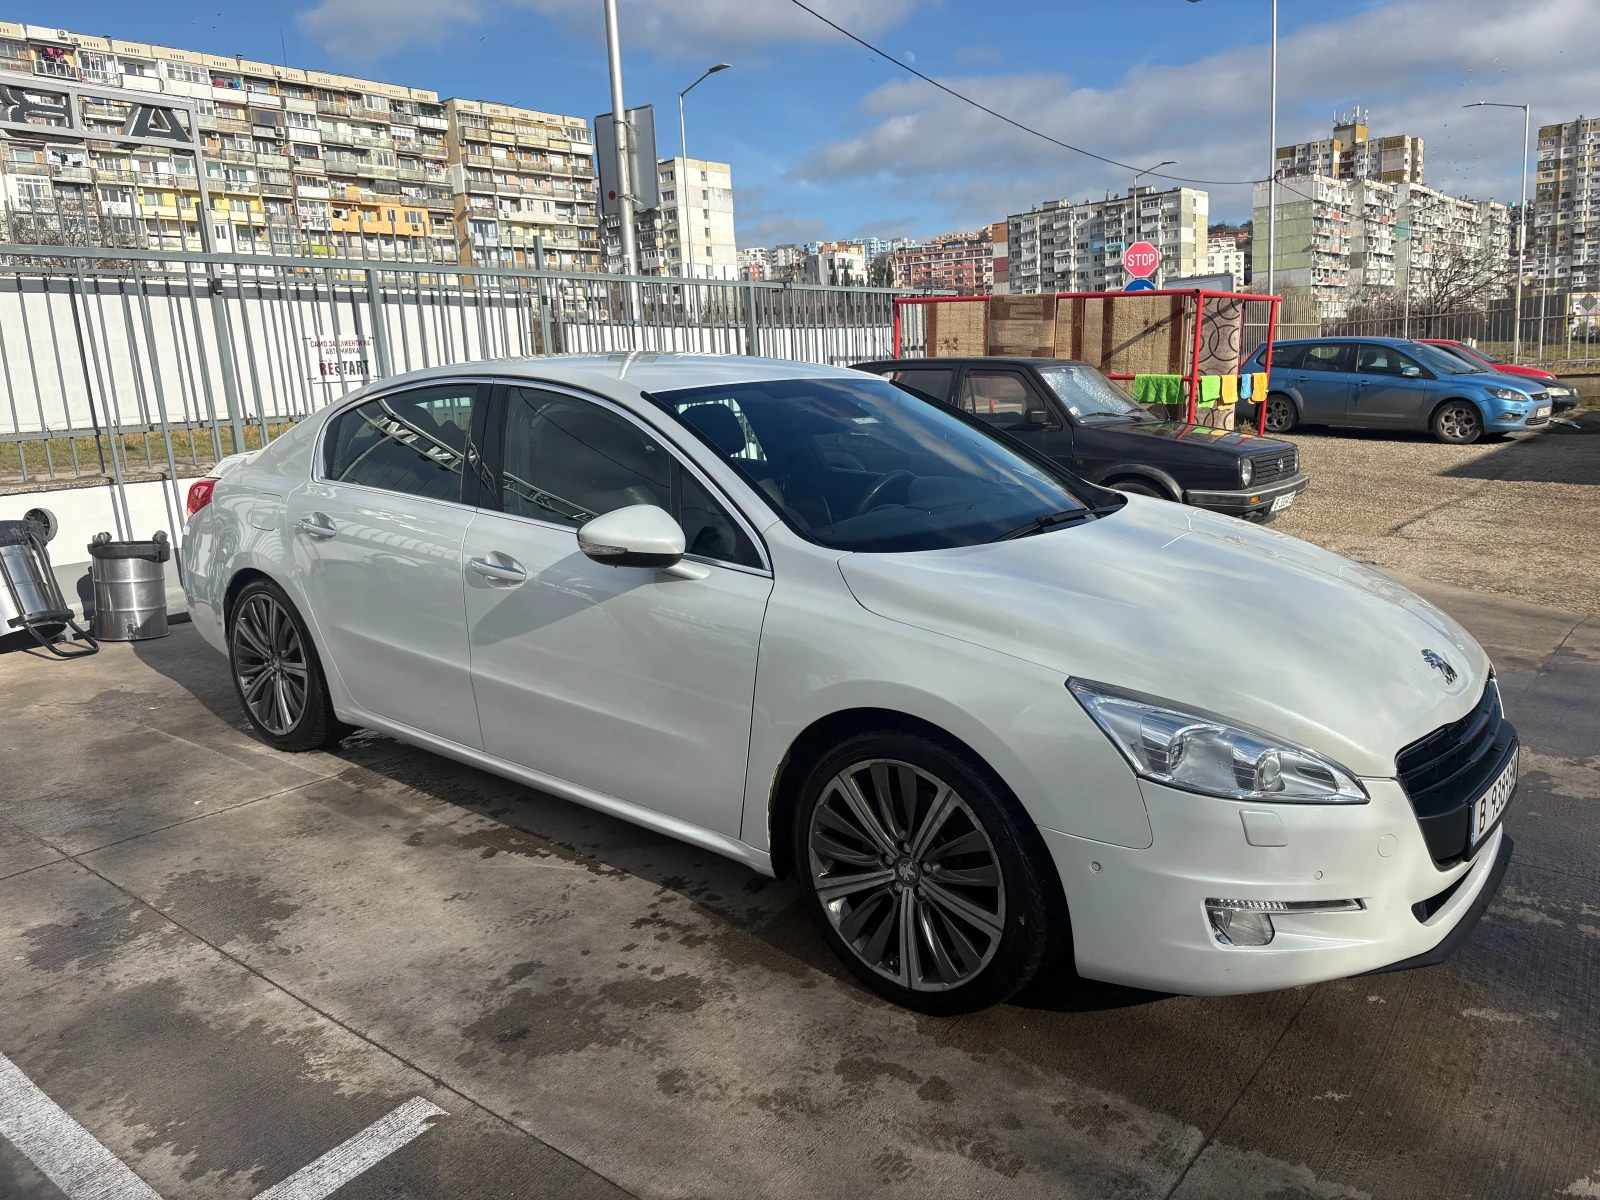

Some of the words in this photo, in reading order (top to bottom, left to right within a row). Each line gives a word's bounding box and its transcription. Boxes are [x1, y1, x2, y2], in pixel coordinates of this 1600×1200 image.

[1127, 253, 1155, 267] STOP
[310, 340, 328, 348] САМО
[338, 339, 363, 347] ЛИЕНТИ
[325, 347, 361, 355] АВТМИВКА
[319, 360, 369, 376] RESTART
[1479, 797, 1487, 835] B
